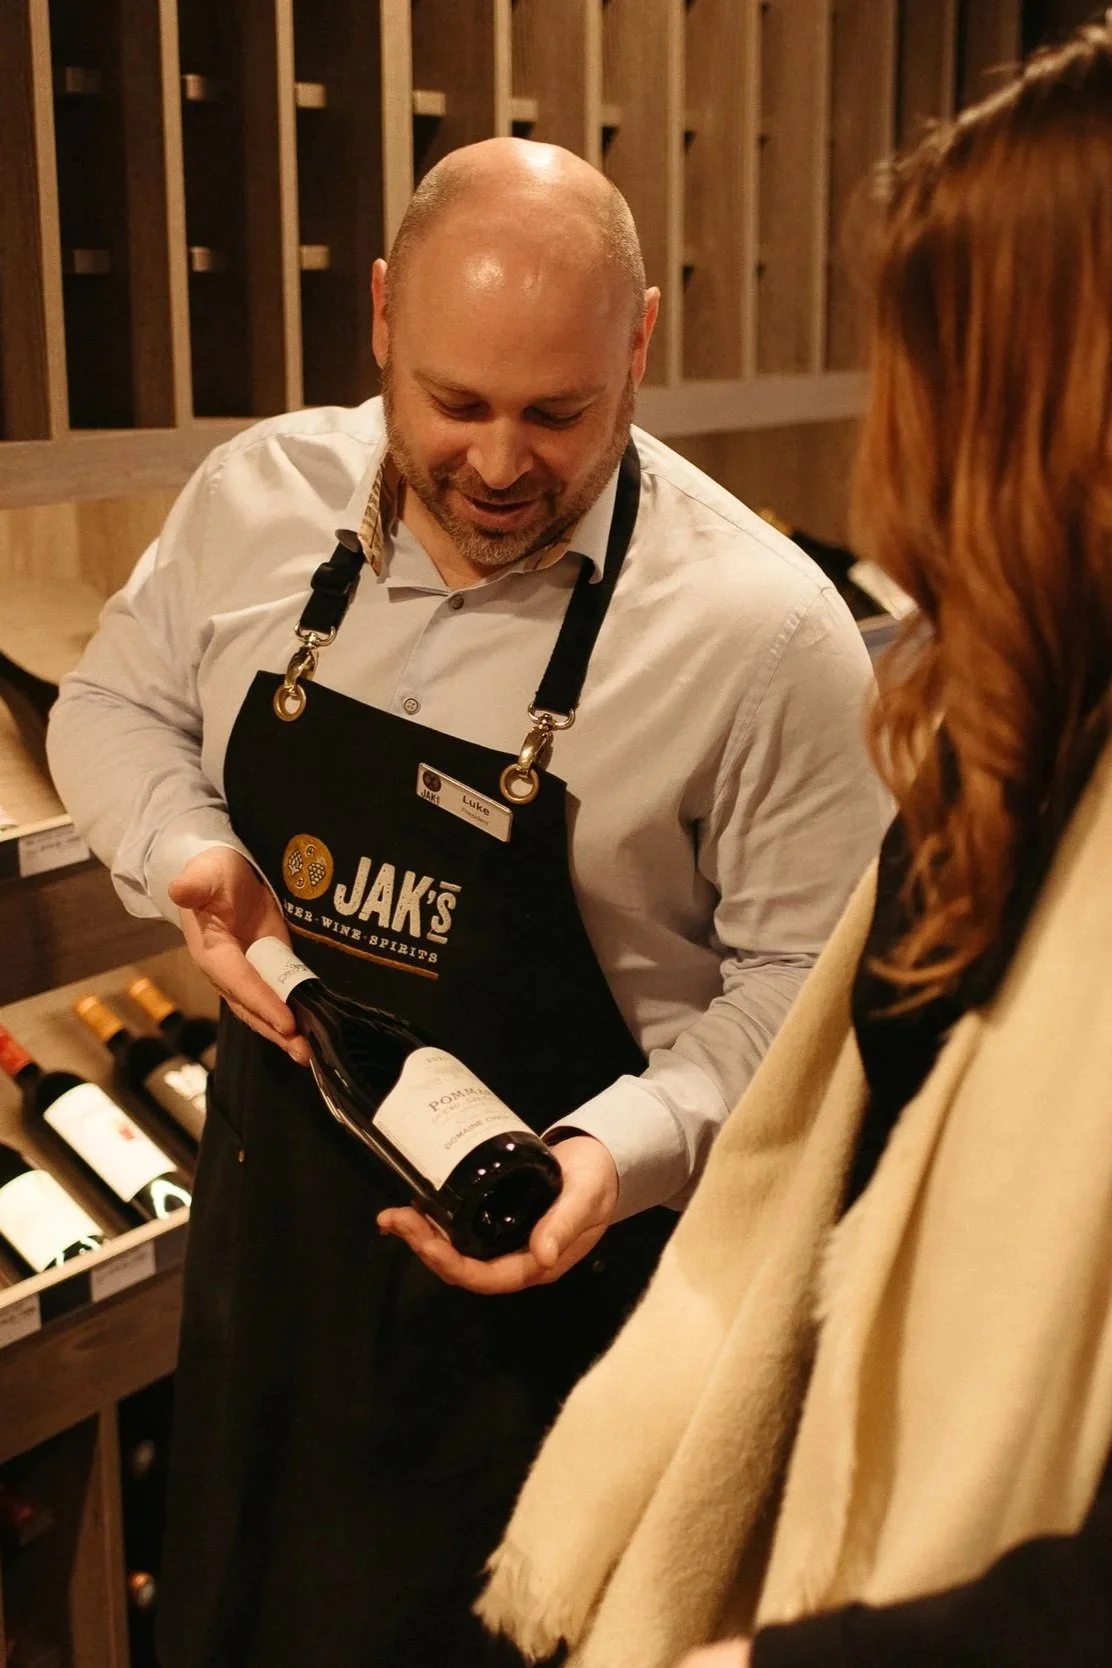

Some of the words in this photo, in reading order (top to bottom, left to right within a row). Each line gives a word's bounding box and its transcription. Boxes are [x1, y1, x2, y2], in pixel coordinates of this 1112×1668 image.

[462, 795, 490, 816] Luke
[285, 901, 313, 922] EER
[321, 915, 362, 940] WINE
[369, 934, 438, 964] SPIRITS
